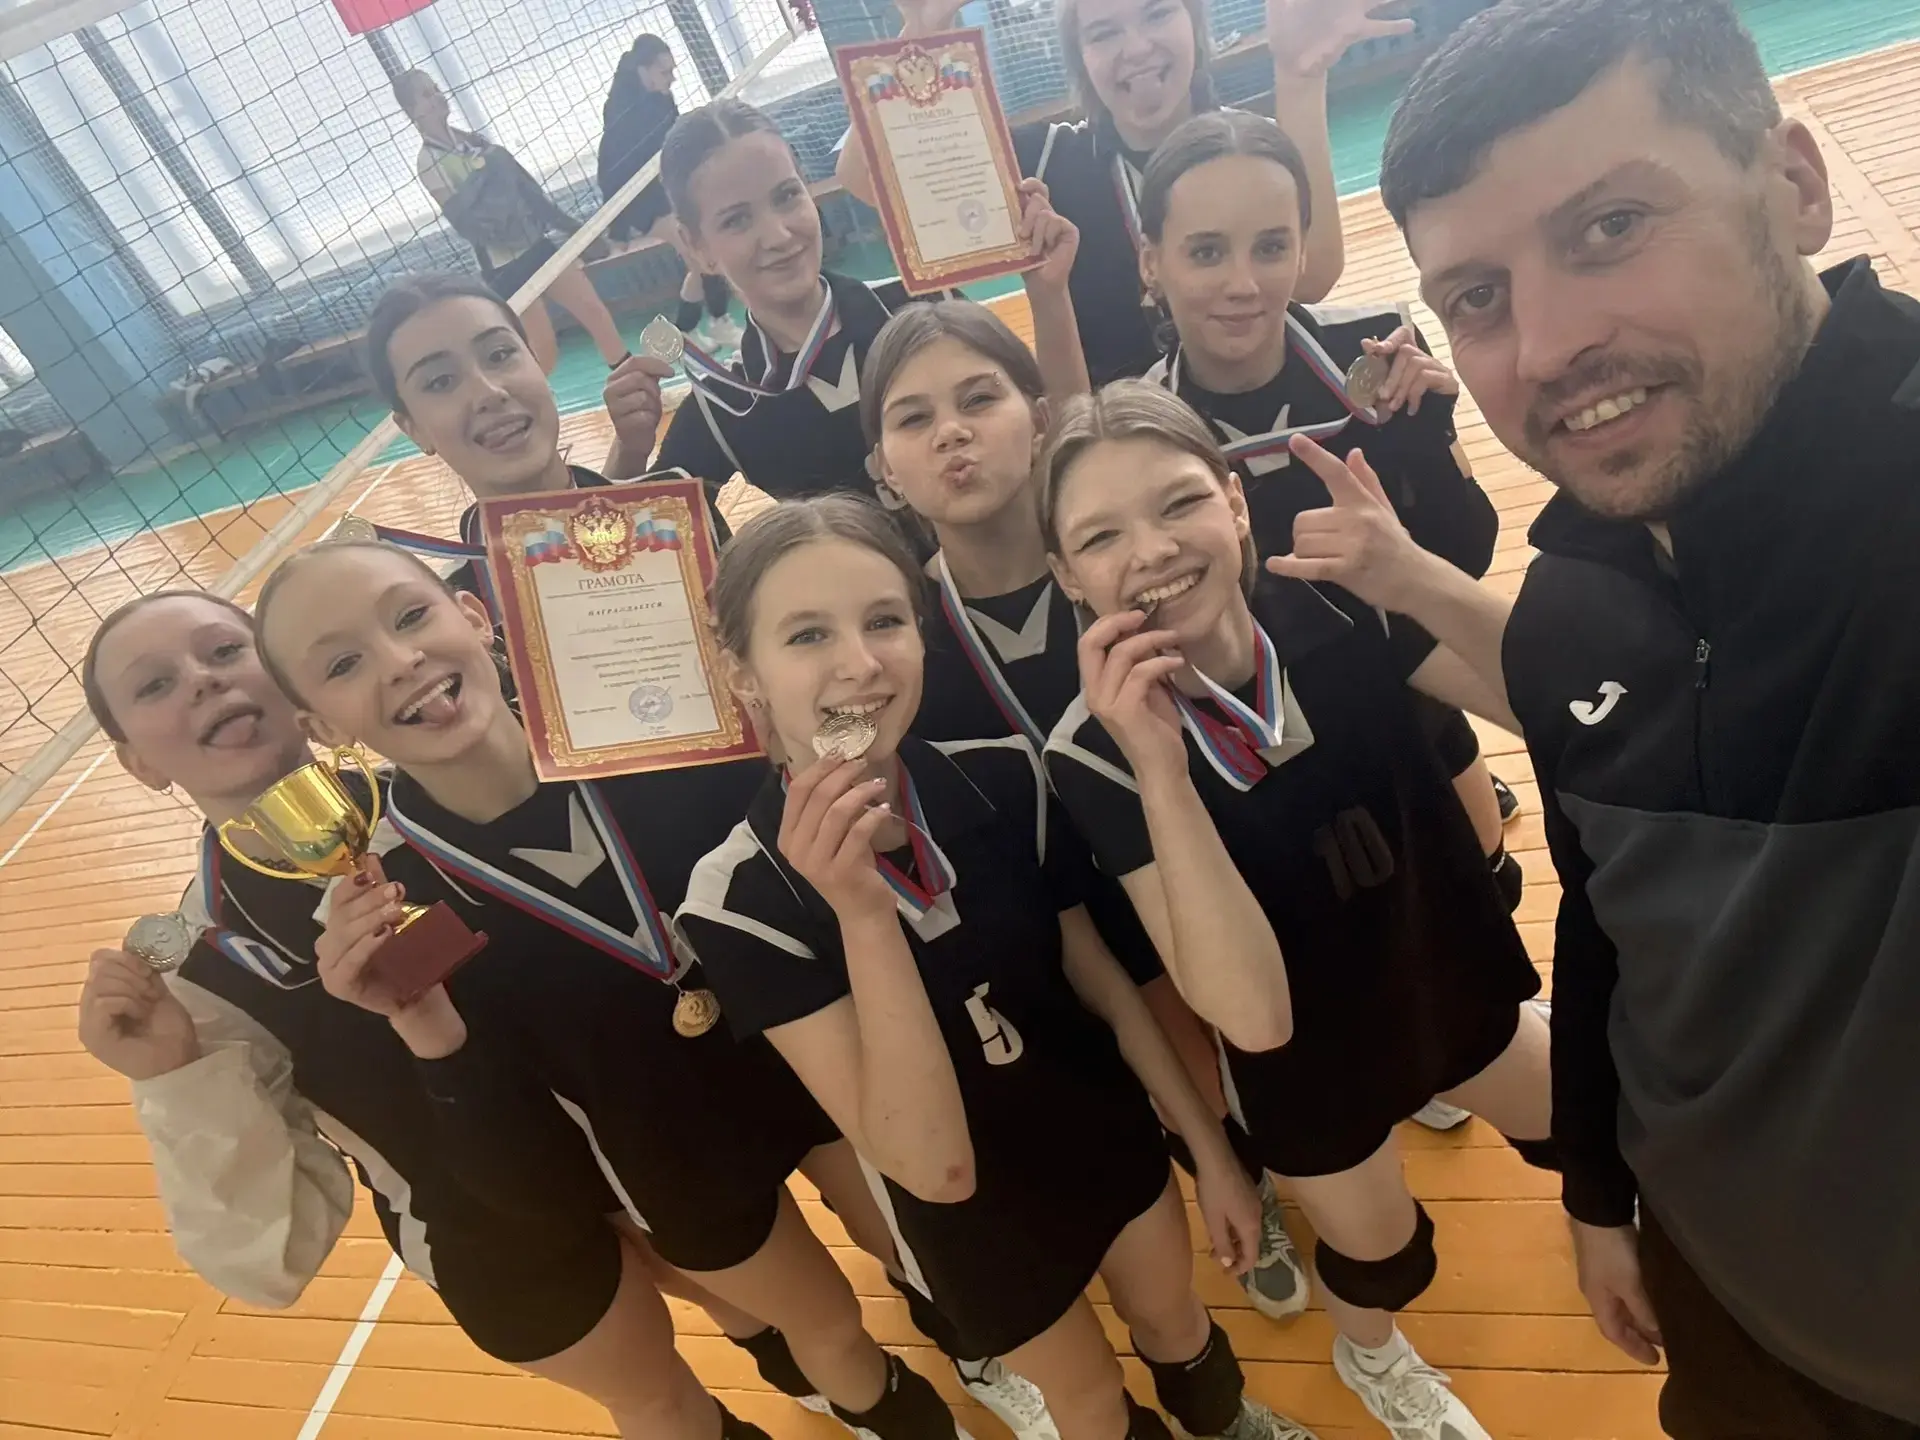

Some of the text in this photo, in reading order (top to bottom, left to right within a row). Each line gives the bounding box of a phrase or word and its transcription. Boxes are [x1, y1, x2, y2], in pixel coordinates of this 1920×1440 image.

[578, 573, 645, 591] ГРАМОТА
[1313, 805, 1394, 901] 10
[964, 981, 1024, 1065] 5
